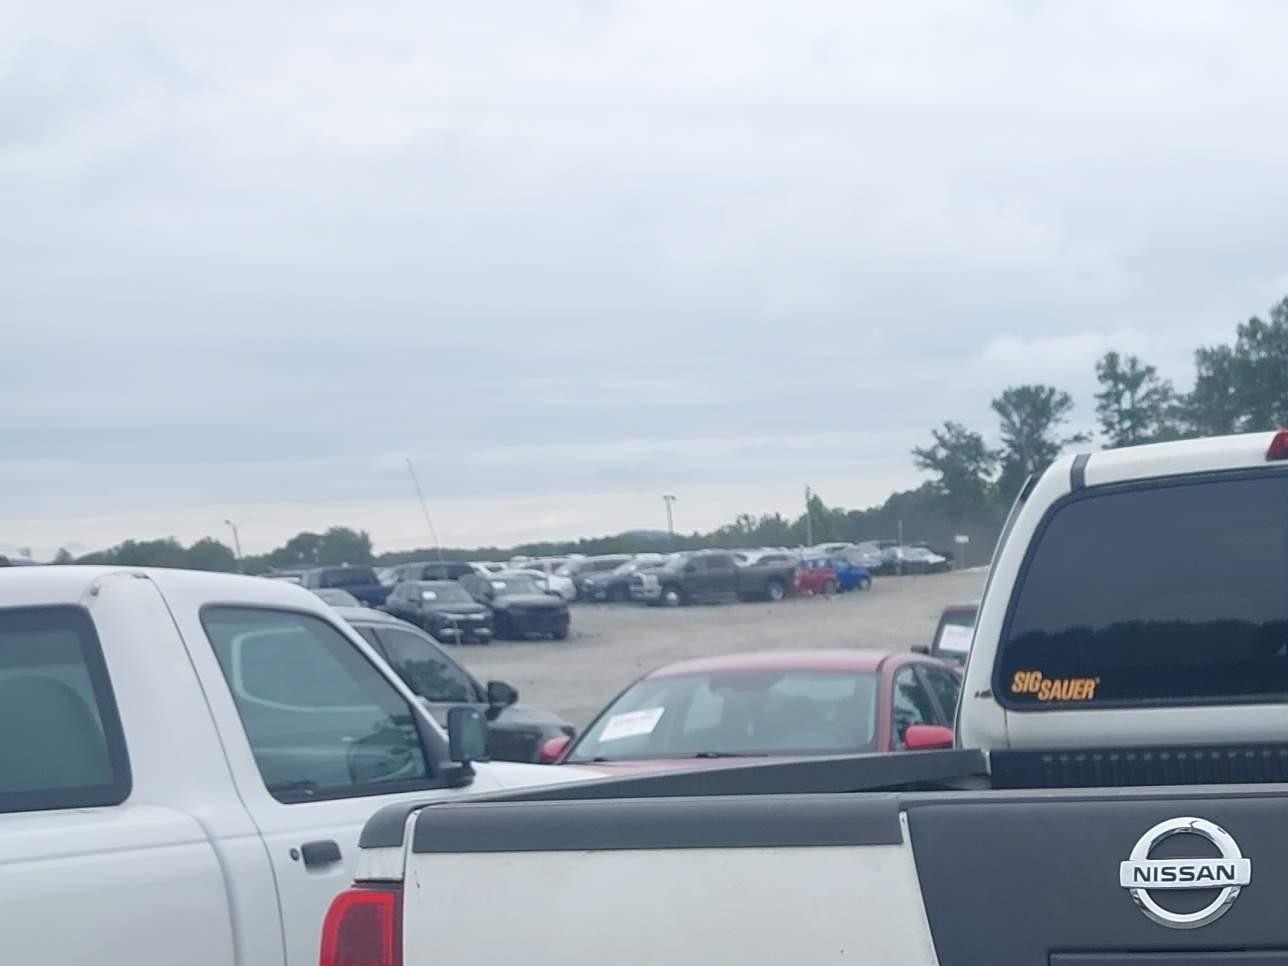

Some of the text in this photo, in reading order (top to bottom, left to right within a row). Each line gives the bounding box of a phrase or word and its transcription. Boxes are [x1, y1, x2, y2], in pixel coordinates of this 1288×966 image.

[1012, 670, 1095, 700] SIG SAUER
[1134, 865, 1235, 882] NISSAN
